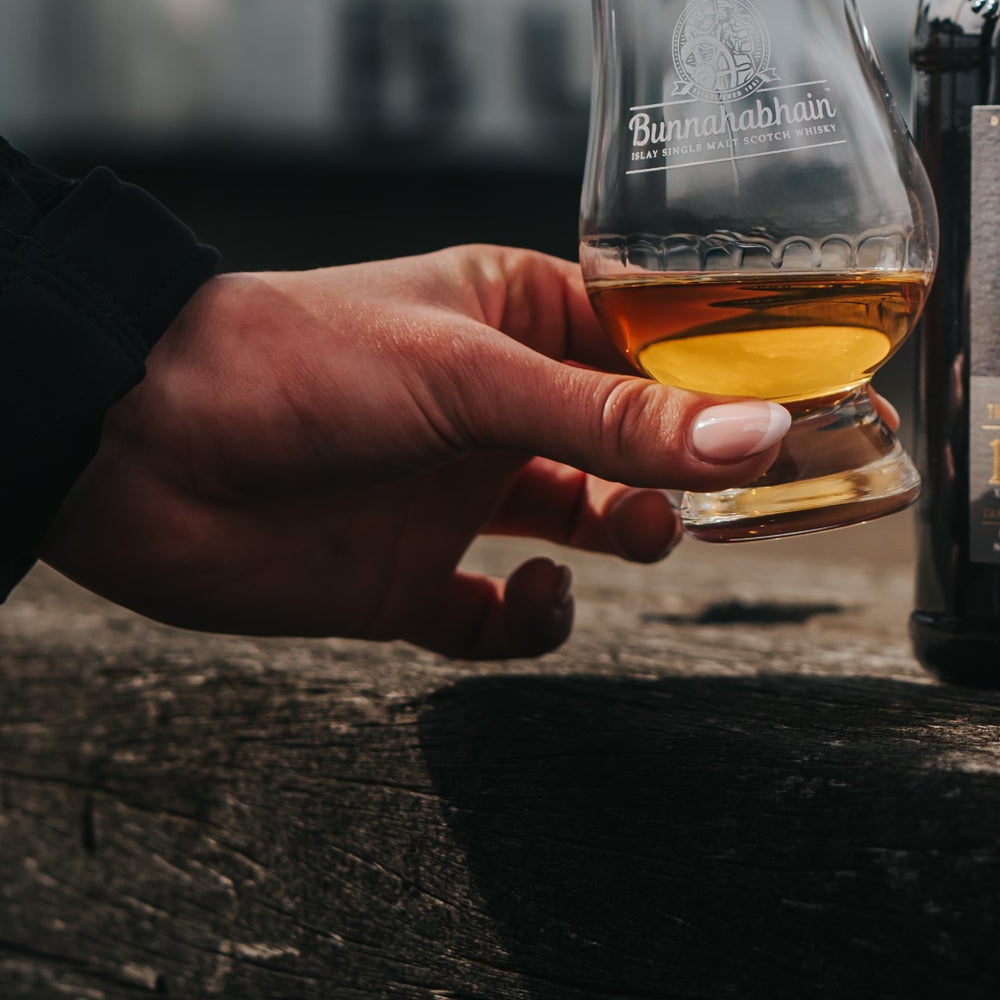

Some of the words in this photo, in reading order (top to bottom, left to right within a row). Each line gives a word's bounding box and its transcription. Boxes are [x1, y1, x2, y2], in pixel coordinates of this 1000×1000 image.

[629, 93, 837, 146] Bunnahabhain
[631, 149, 659, 161] ISLAY
[661, 143, 703, 156] SINGLE
[706, 137, 740, 150] MALT
[743, 130, 791, 145] SCOTCH
[795, 123, 838, 138] WHISKY
